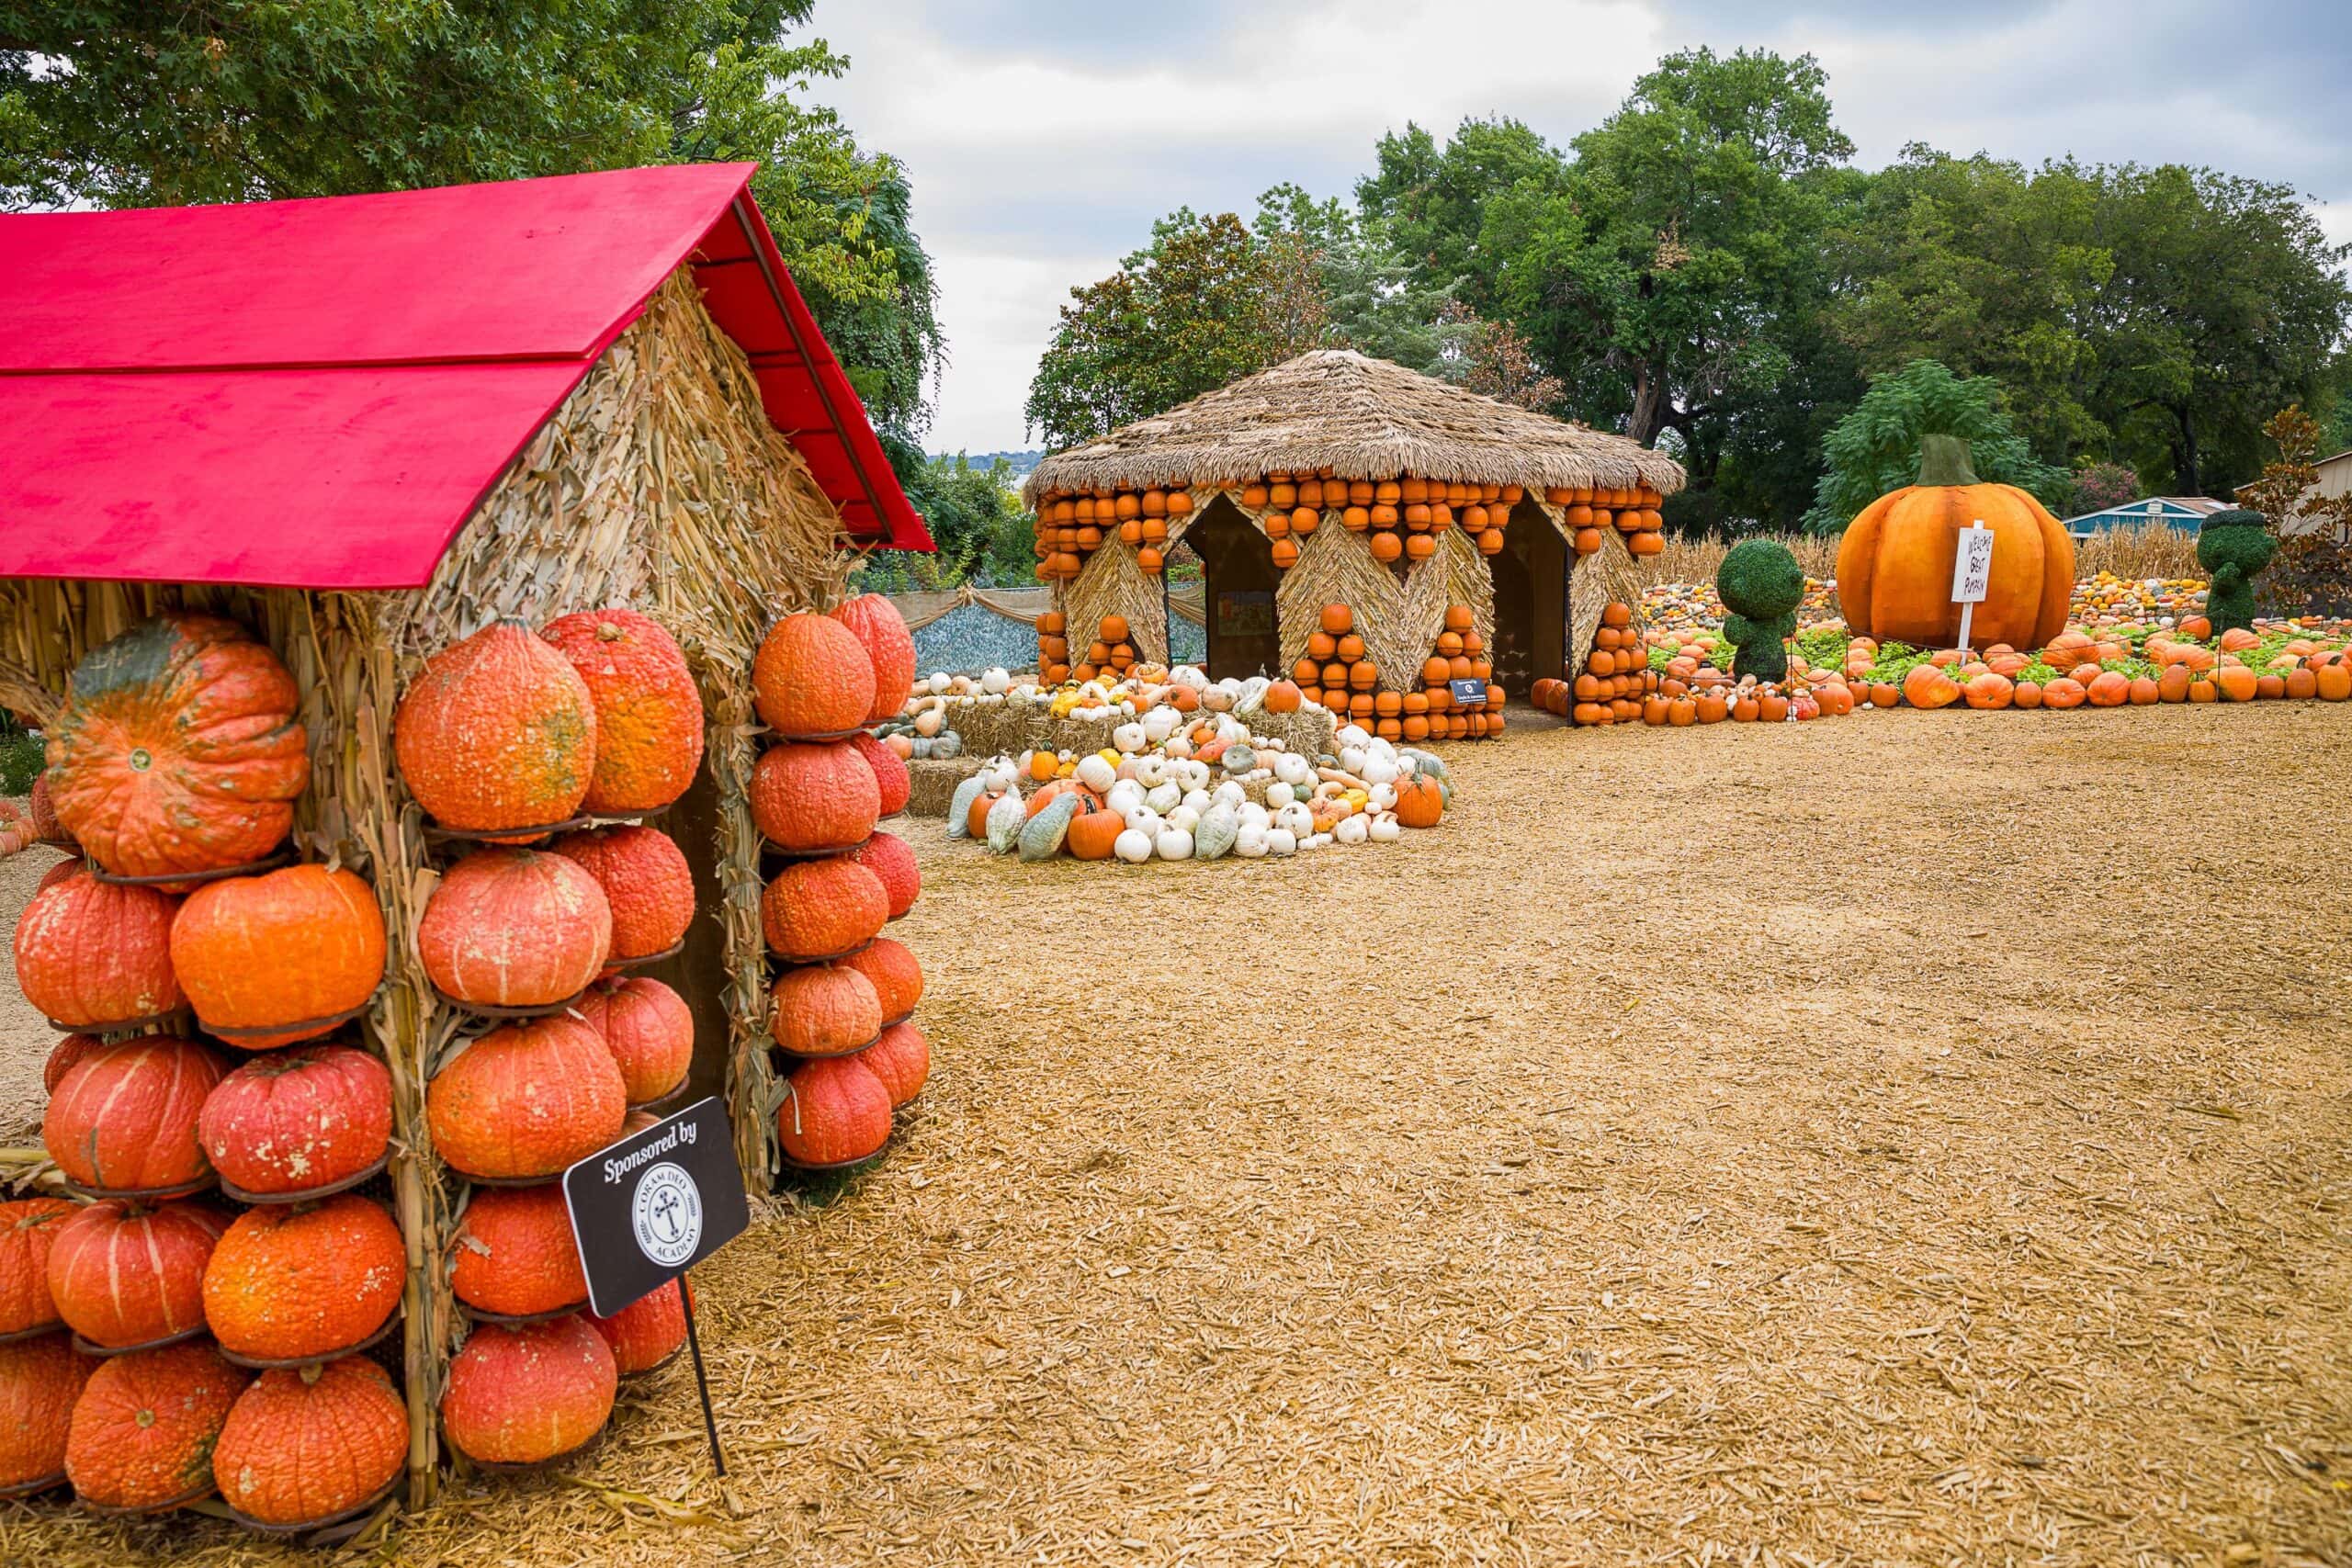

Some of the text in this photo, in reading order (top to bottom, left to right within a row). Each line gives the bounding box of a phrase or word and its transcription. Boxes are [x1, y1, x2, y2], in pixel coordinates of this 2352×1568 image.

[1968, 535, 1992, 556] WELCOME
[1963, 576, 1985, 595] PUMPKIN
[604, 1121, 696, 1184] Sponsored by
[639, 1171, 686, 1213] CORAM DEO
[656, 1228, 696, 1258] ACADEMY
